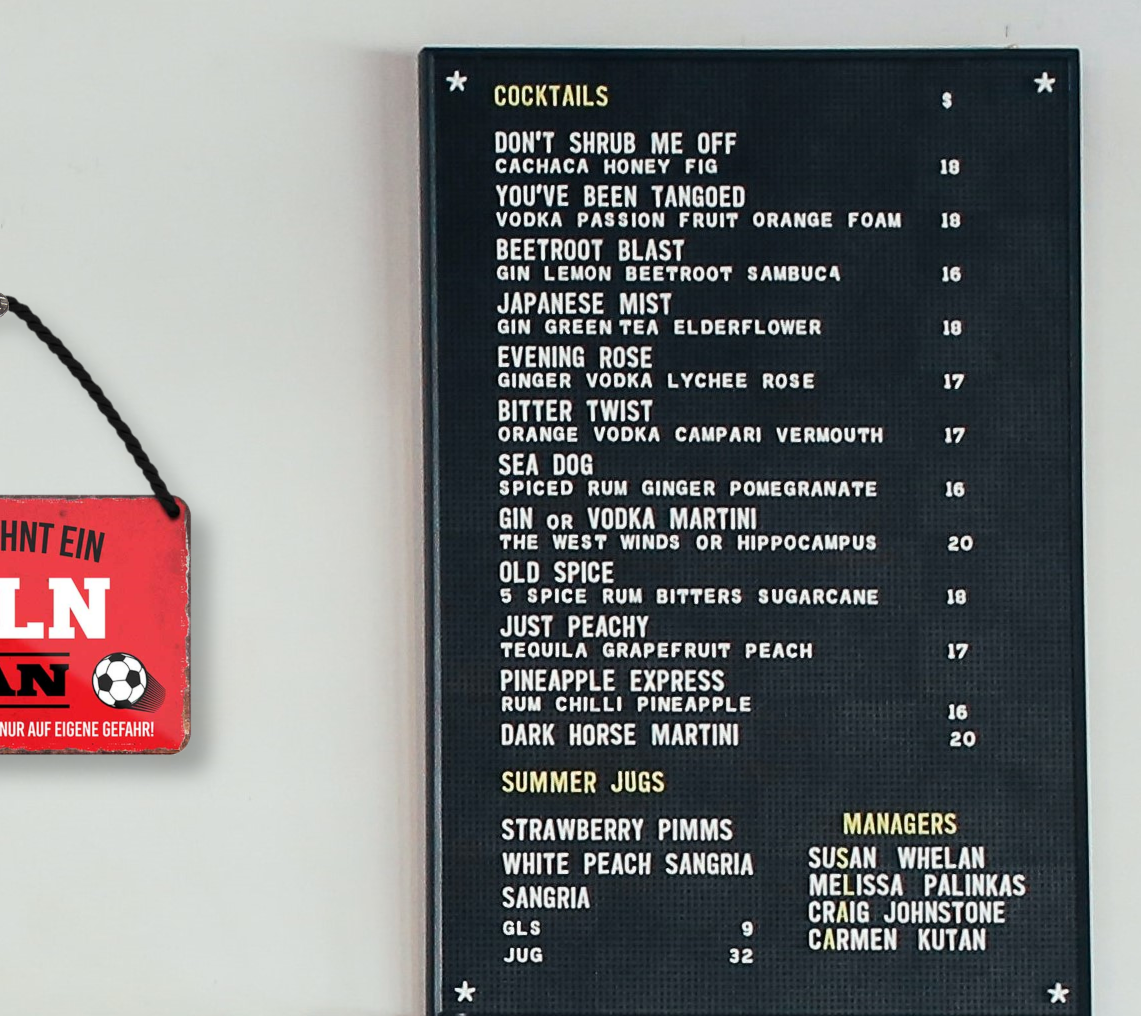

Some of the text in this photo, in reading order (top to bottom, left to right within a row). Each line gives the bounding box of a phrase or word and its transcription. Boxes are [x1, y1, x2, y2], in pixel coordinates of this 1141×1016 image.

[495, 85, 953, 109] COCKTAILS $
[495, 131, 736, 154] DON'T SHRUB ME OFF
[496, 158, 959, 174] CACHACA HONEY FIG 18
[496, 184, 745, 207] YOU'VE BEEN TANGOED
[496, 212, 960, 228] VODKA PASSION FRUIT ORANGE FOAM 18
[497, 239, 684, 261] BEETROOT BLAST
[497, 266, 529, 281] GIN
[545, 266, 611, 281] LEMON
[626, 266, 732, 281] BEETROOT
[942, 267, 961, 281] 16
[497, 292, 671, 315] JAPANESE MIST
[498, 319, 961, 335] GIN GREEN TEA ELDERFLOWER 18
[498, 346, 652, 369] EVENING ROSE
[498, 373, 964, 389] GINGER VODKA LYCHEE ROSE 17
[499, 400, 652, 422] BITTER TWIST
[499, 426, 965, 443] ORANGE VODKA CAMPARI VERMOUTH 17
[499, 454, 593, 475] SEA DOG
[500, 480, 964, 497] SPICED RUM GINGER POMEGRANATE 16
[500, 507, 756, 530] GIN OR VODKA MARTINI
[60, 526, 105, 563] EIN
[500, 534, 973, 551] THE WEST WINDS OR HIPPOCAMPUS 20
[500, 561, 613, 583] OLD SPICE
[501, 588, 966, 605] 5 SPICE RUM BITTERS SUGARCANE 18
[500, 615, 648, 637] JUST PEACHY
[501, 642, 968, 659] TEQUILA GRAPEFRUIT PEACH 17
[501, 669, 724, 692] PINEAPPLE EXPRESS
[502, 696, 967, 719] RUM CHILLI PINEAPPLE 16
[0, 721, 24, 738] NUR
[27, 721, 51, 738] AUF
[55, 721, 99, 738] EIGENE
[102, 721, 154, 738] GEFAHR!
[502, 723, 975, 747] DARK HORSE MARTINI 20
[502, 771, 664, 793] SUMMER JUGS
[502, 819, 732, 841] STRAWBERRY PIMMS
[844, 813, 957, 835] MANAGERS
[503, 853, 753, 875] WHITE PEACH SANGRIA
[809, 847, 984, 869] SUSAN WHELAN
[810, 874, 1025, 896] MELISSA PALINKAS
[503, 886, 590, 908] SANGRIA
[809, 901, 1005, 923] CRAIG JOHNSTONE
[503, 921, 753, 936] GLS 9
[809, 928, 985, 951] CARMEN KUTAN
[504, 948, 753, 963] JUG 32
